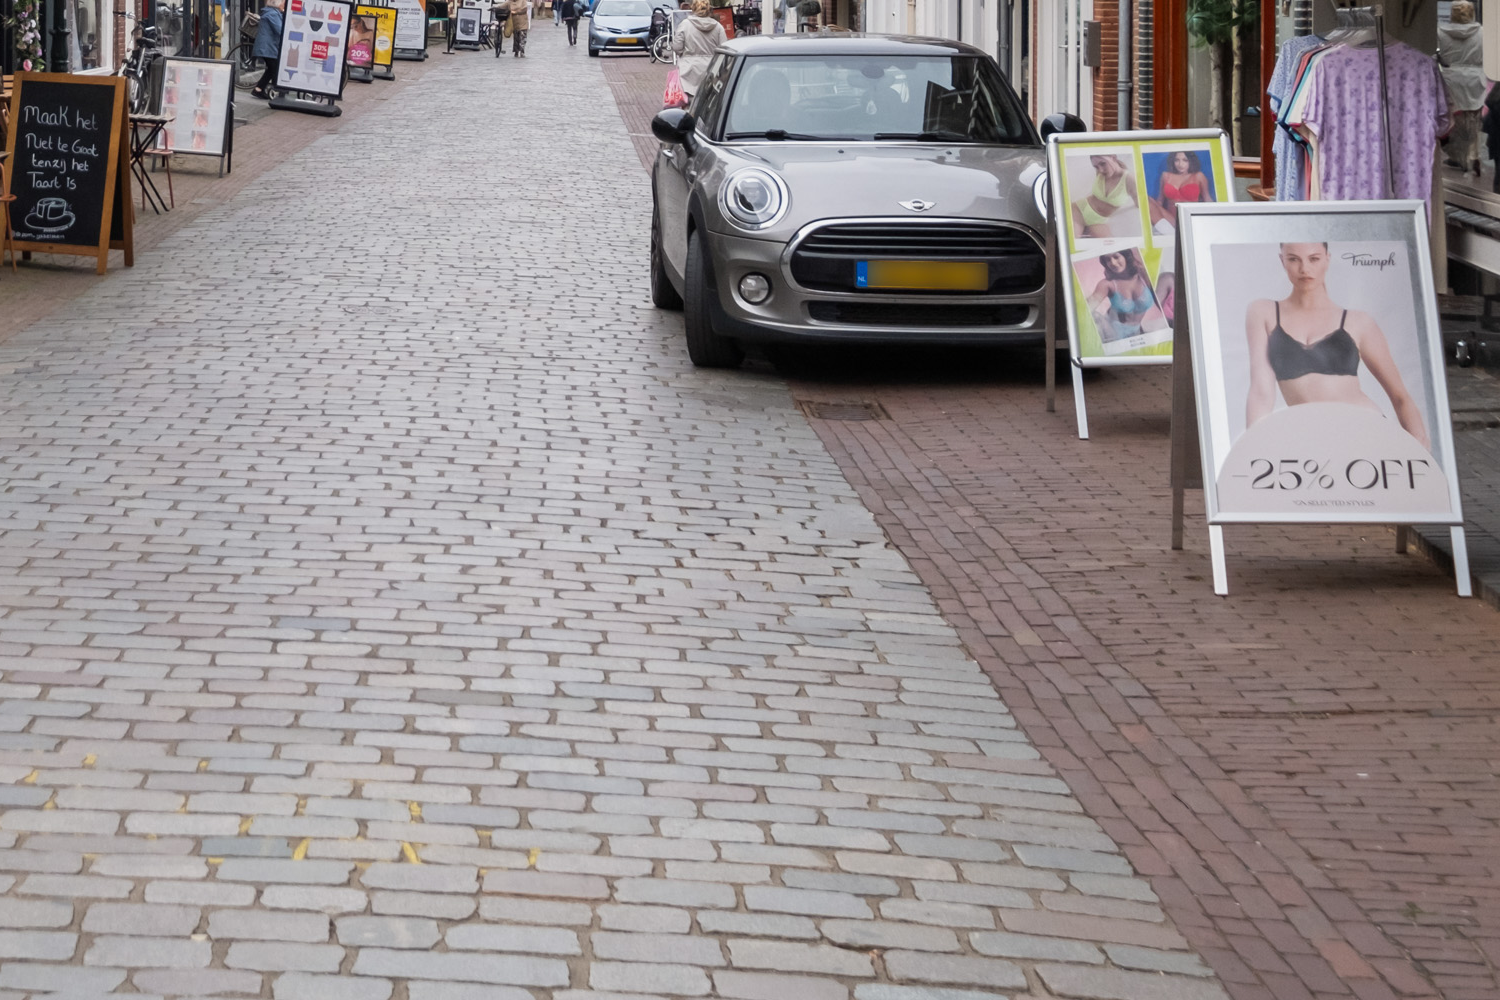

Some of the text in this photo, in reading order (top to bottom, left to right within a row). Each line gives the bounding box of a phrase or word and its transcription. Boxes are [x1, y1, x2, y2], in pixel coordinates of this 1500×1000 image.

[375, 11, 388, 19] bril
[350, 49, 370, 58] 20%
[76, 109, 98, 130] het
[57, 136, 69, 153] te
[31, 153, 89, 174] tenzij het
[26, 171, 61, 189] Taart
[1341, 251, 1396, 271] Triumph
[1345, 458, 1430, 490] OFF
